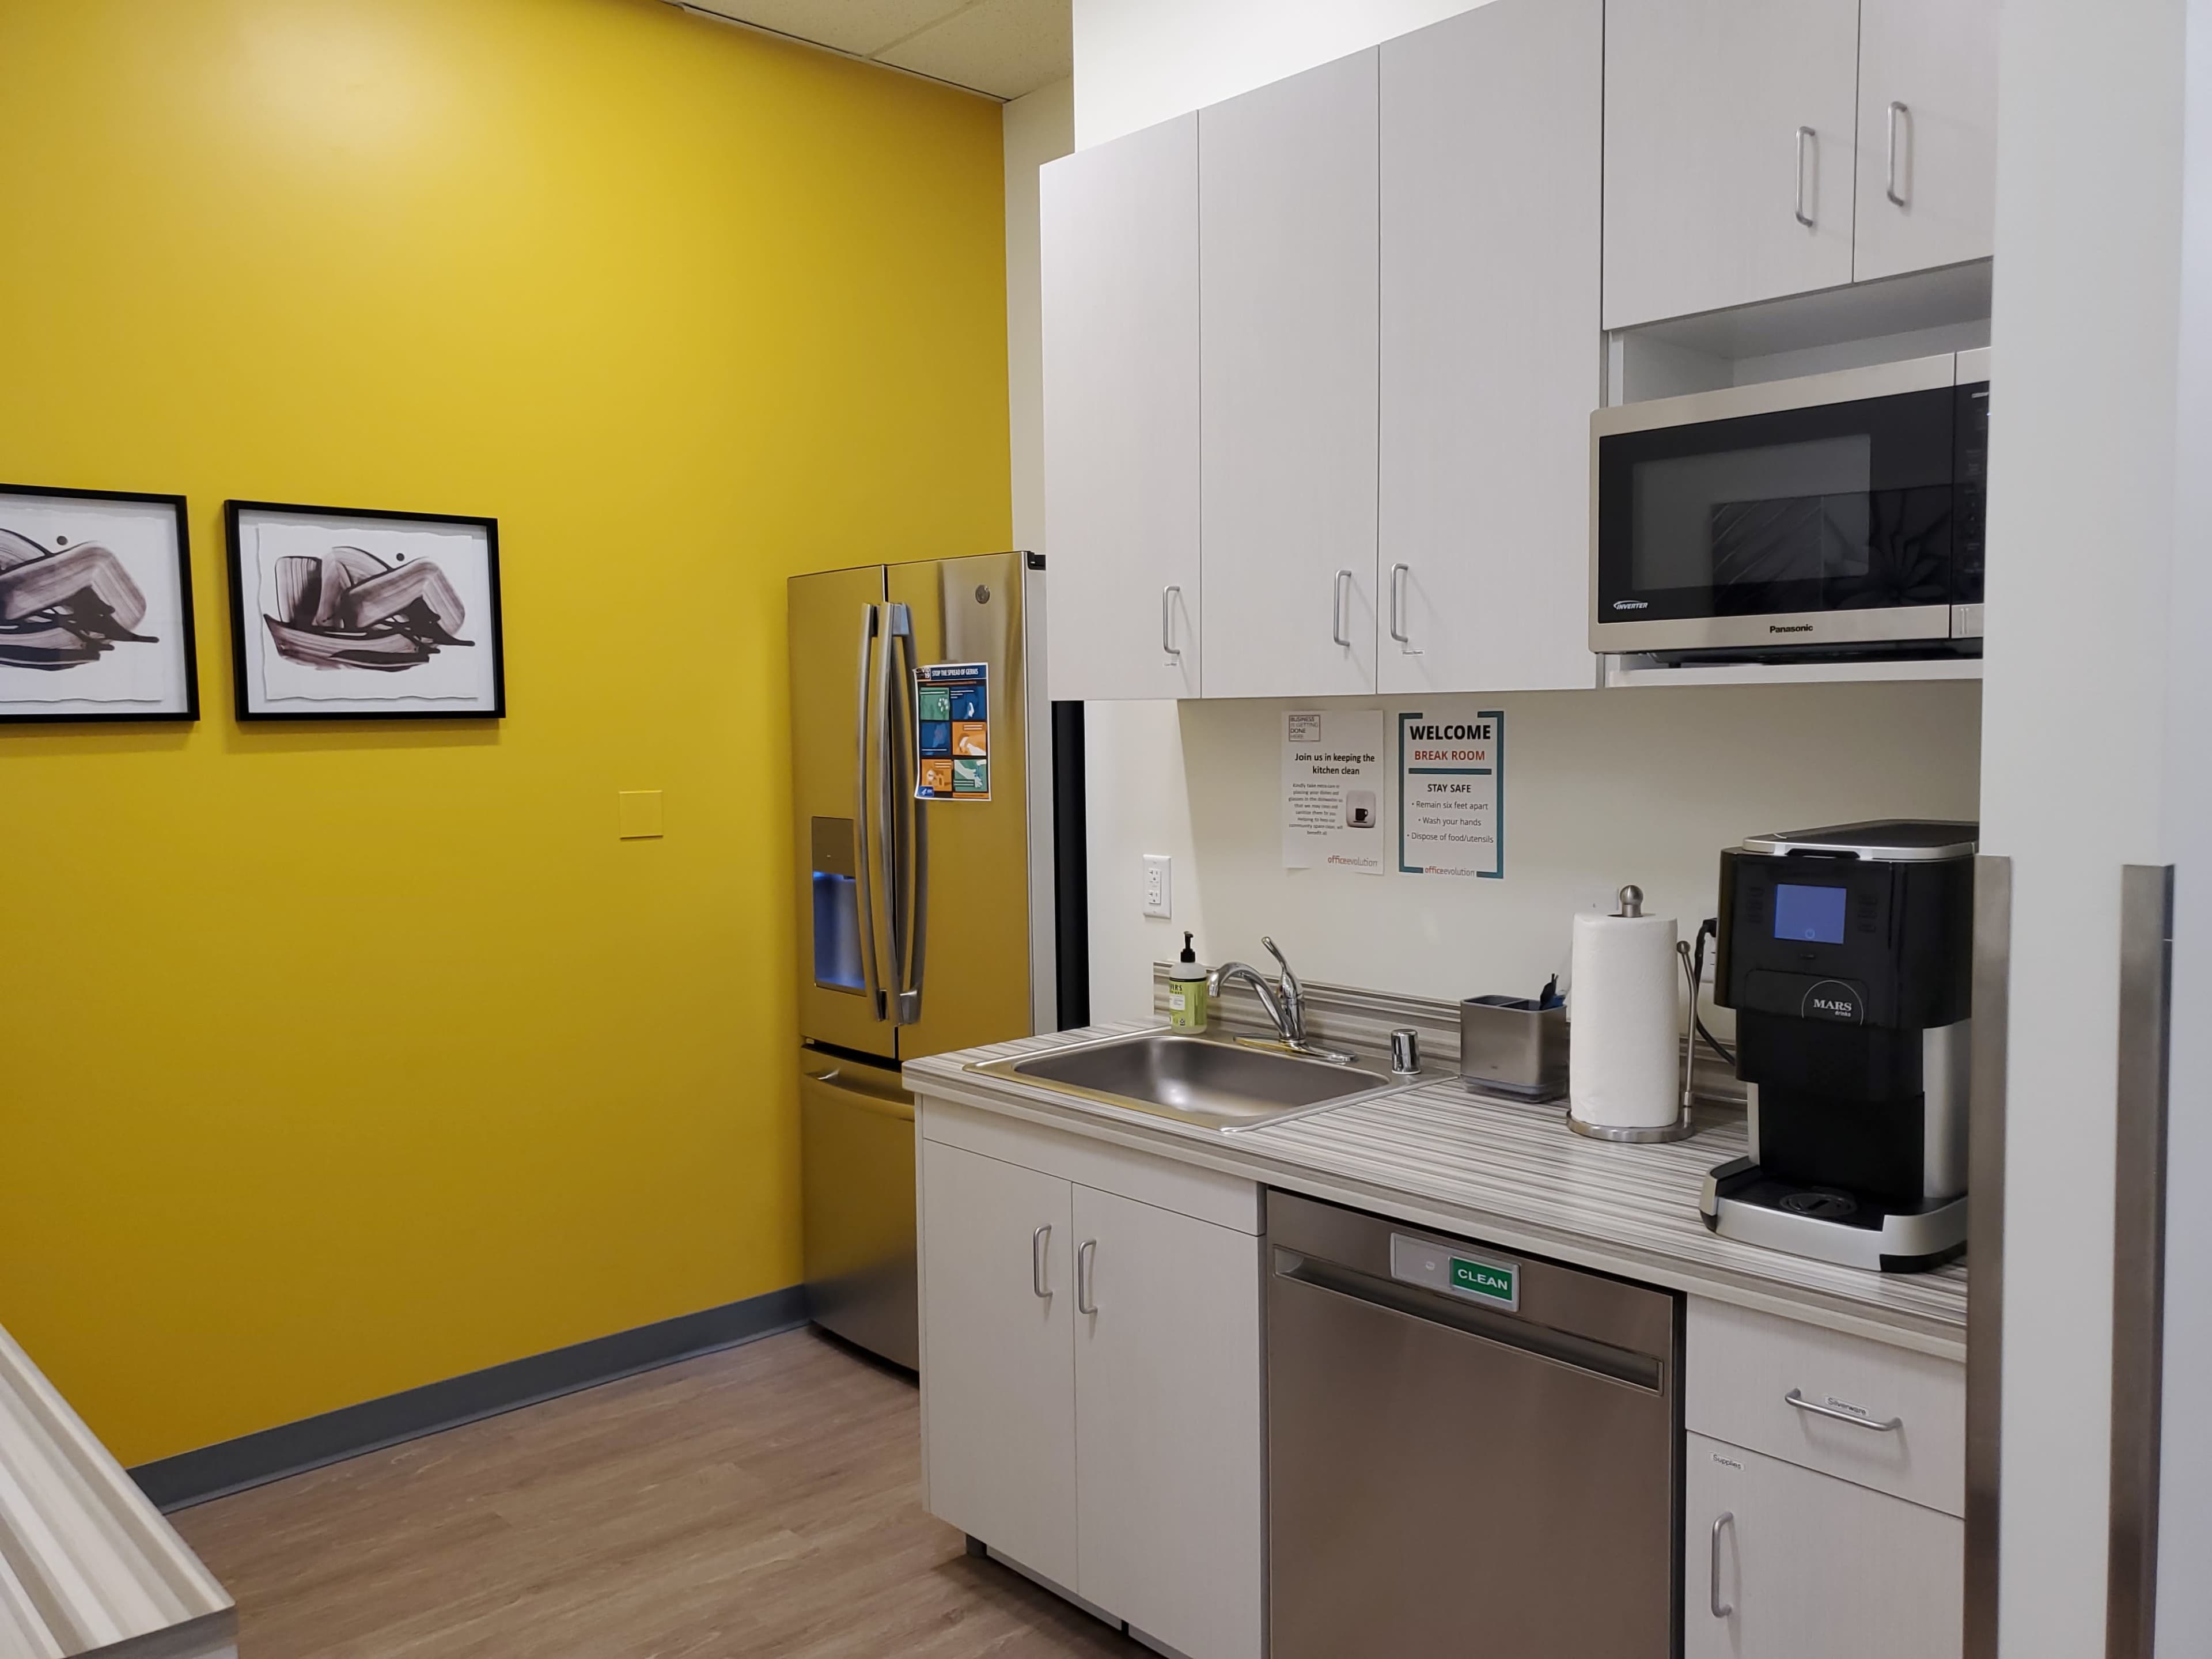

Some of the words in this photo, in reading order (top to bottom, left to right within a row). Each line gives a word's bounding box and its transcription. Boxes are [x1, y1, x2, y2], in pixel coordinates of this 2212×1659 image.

[1770, 624, 1813, 633] Panasonic
[1410, 725, 1491, 740] WELCOME
[1295, 753, 1312, 762] Join
[1325, 753, 1331, 762] in
[1333, 753, 1361, 764] keeping
[1363, 754, 1375, 762] the
[1415, 751, 1448, 760] BREAK
[1452, 751, 1485, 760] ROOM
[1312, 766, 1339, 775] kitchen
[1341, 766, 1360, 775] clean
[1427, 783, 1448, 793] STAY
[1450, 784, 1471, 793] SAFE
[1469, 802, 1488, 811] apart
[1442, 819, 1457, 827] your
[1460, 818, 1482, 826] hands
[1411, 832, 1438, 842] Dispose
[1440, 833, 1446, 841] of
[1448, 834, 1494, 843] food/utensils
[1813, 999, 1852, 1012] MARS
[1457, 1268, 1508, 1290] CLEAN
[1827, 1397, 1866, 1416] Silverware
[1713, 1454, 1741, 1470] Supplies
